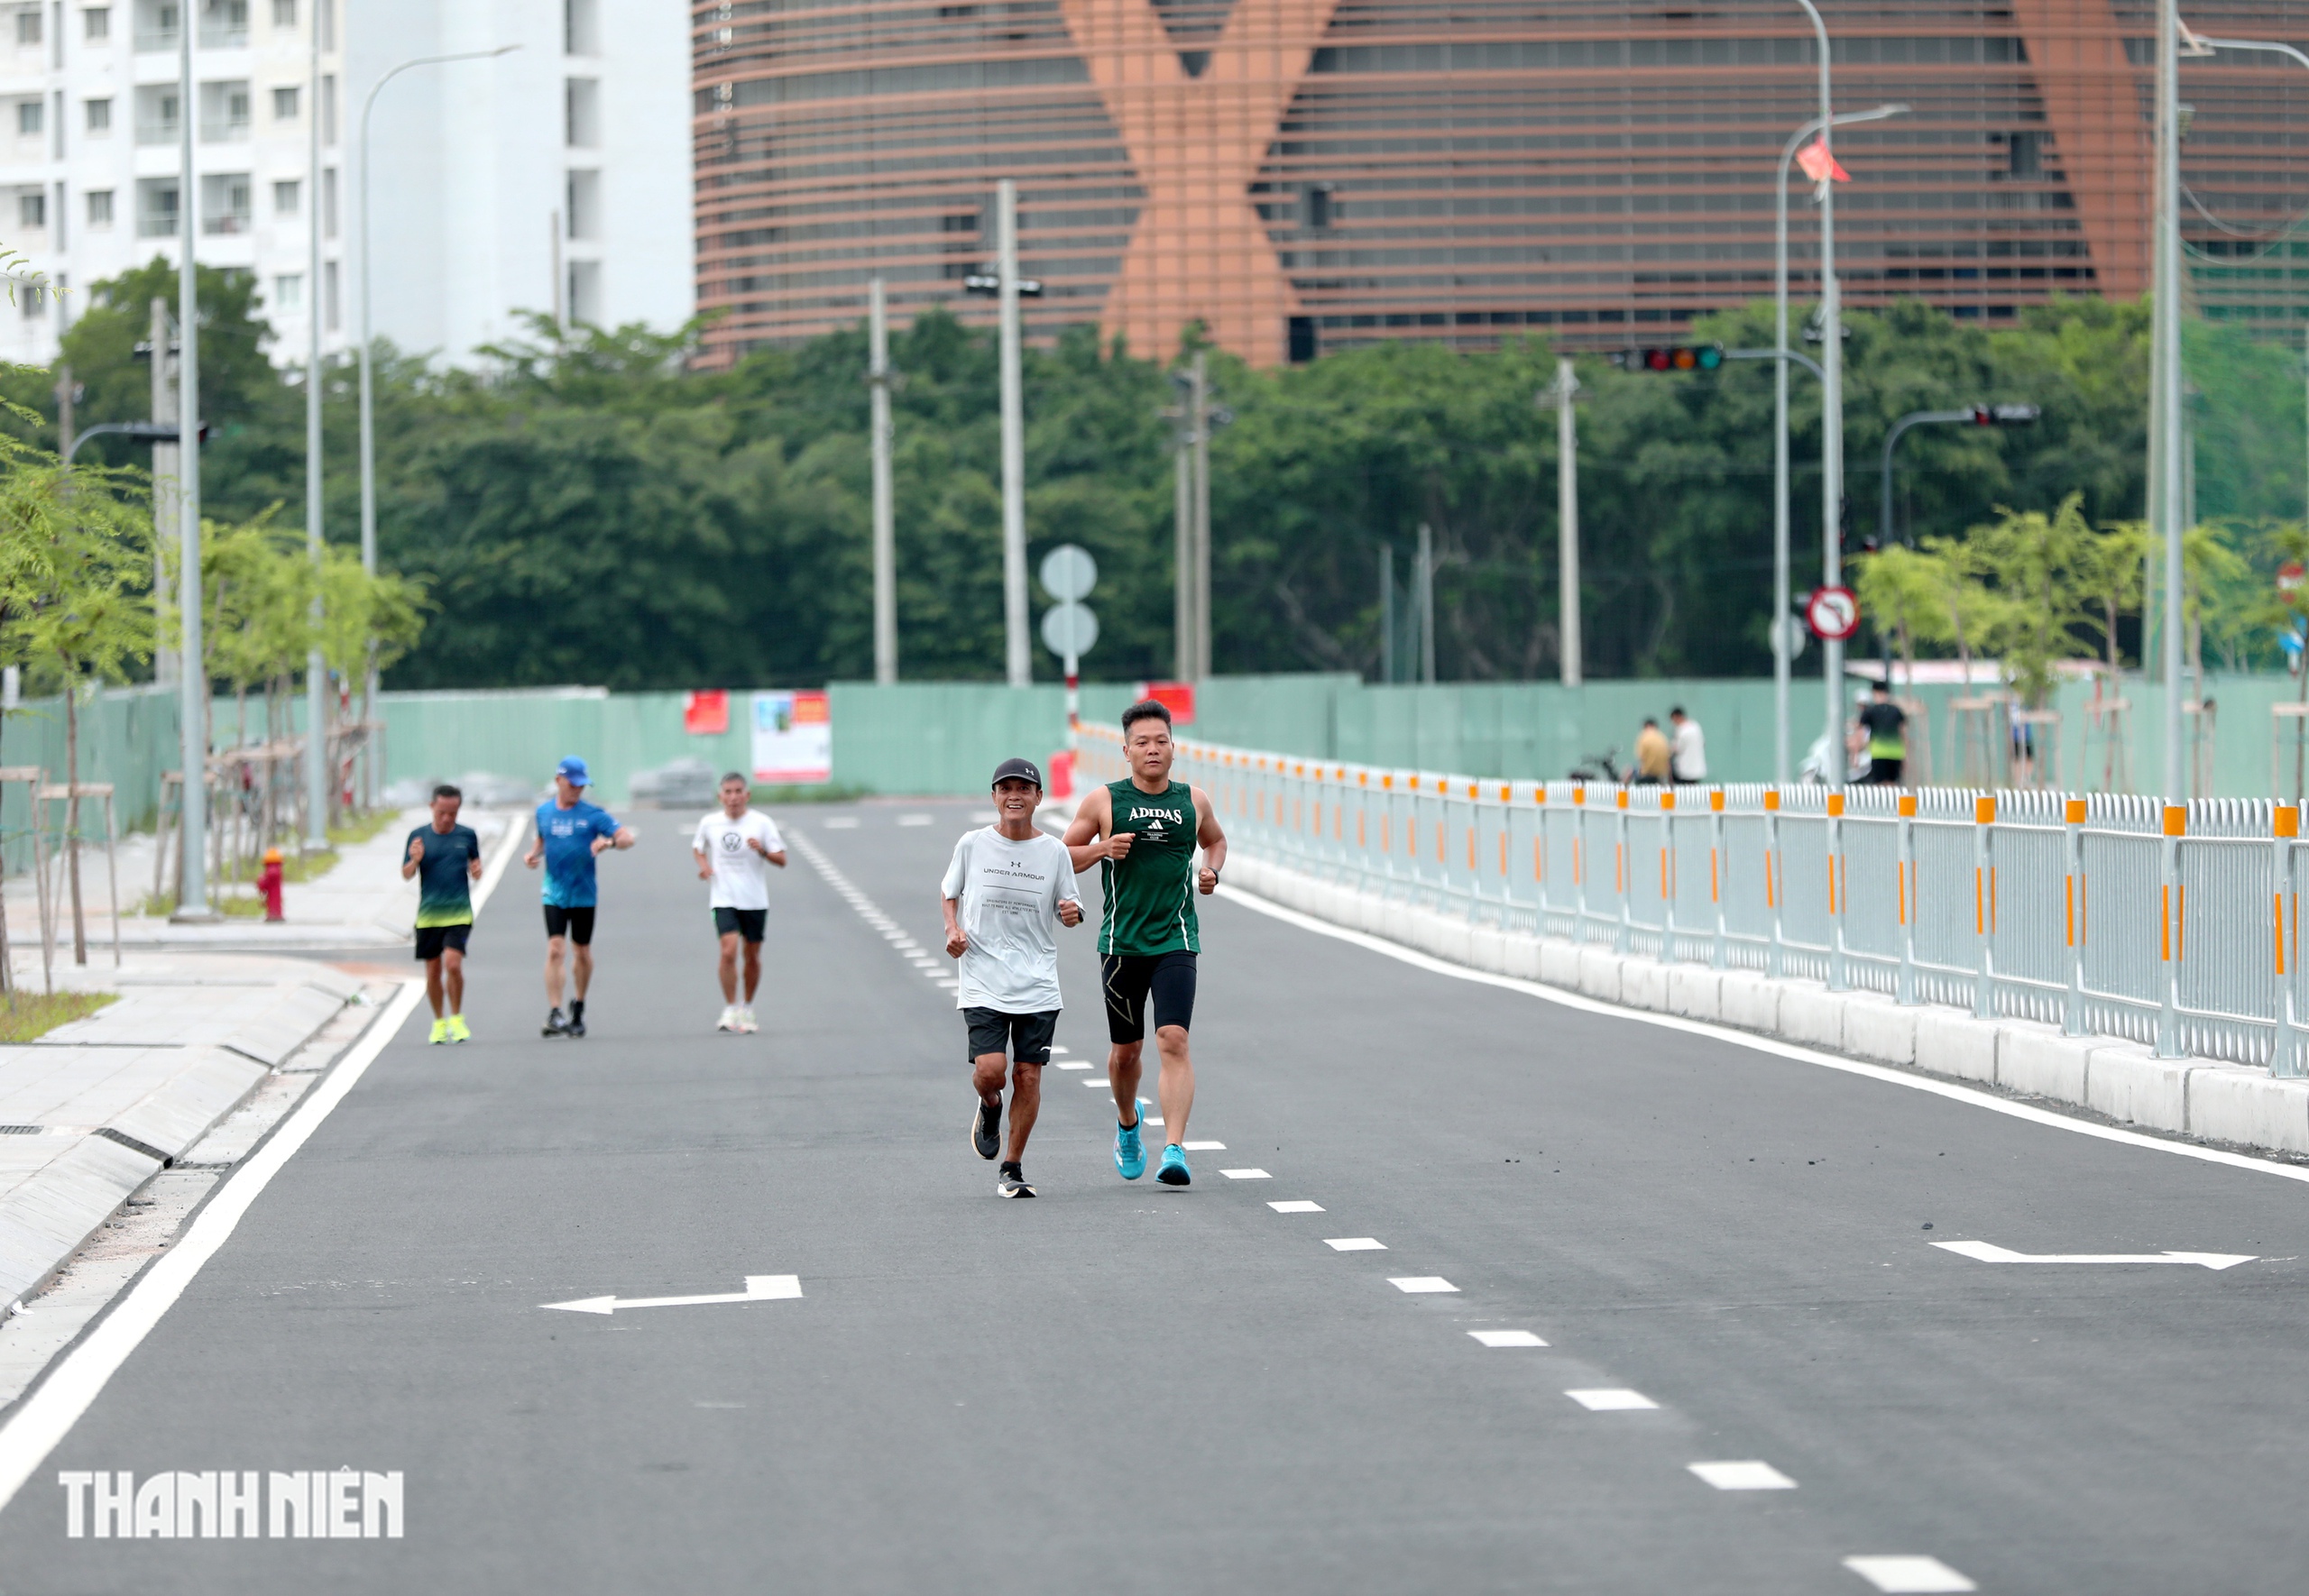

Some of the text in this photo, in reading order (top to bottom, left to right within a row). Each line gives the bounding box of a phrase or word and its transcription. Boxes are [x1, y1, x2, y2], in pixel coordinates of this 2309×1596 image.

[1128, 807, 1182, 825] ADIDAS
[983, 868, 1044, 880] UNDER ARMOUR
